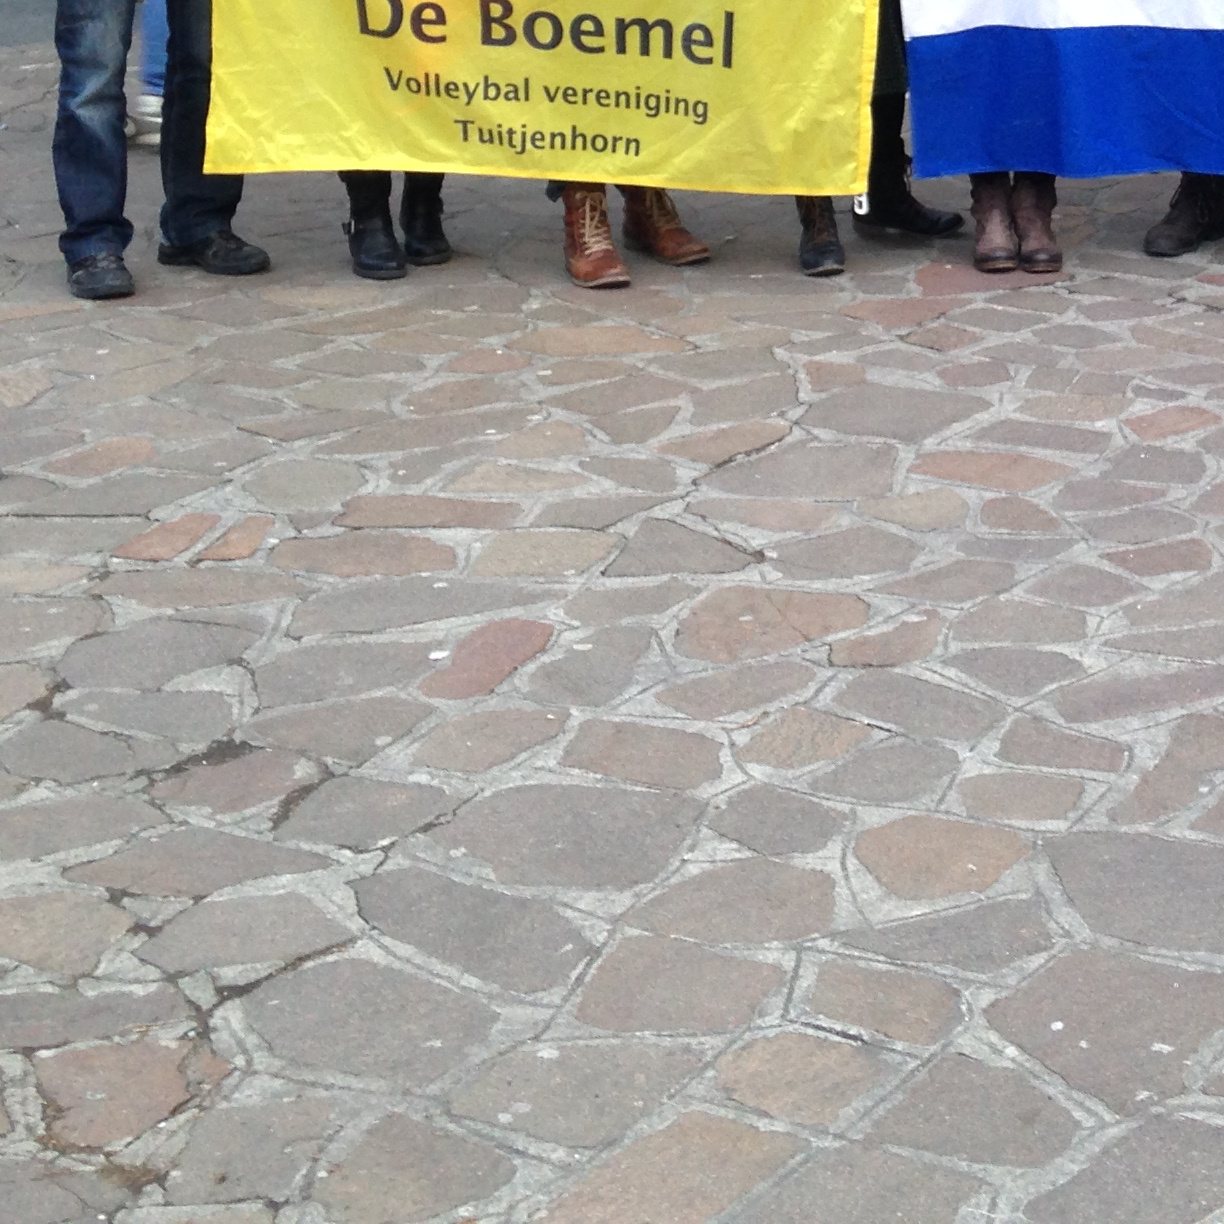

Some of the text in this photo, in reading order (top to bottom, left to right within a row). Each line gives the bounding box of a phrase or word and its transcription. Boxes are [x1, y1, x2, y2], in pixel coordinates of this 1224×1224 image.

[383, 66, 709, 125] Volleybal vereniging
[453, 119, 641, 157] Tuitjenhorn
